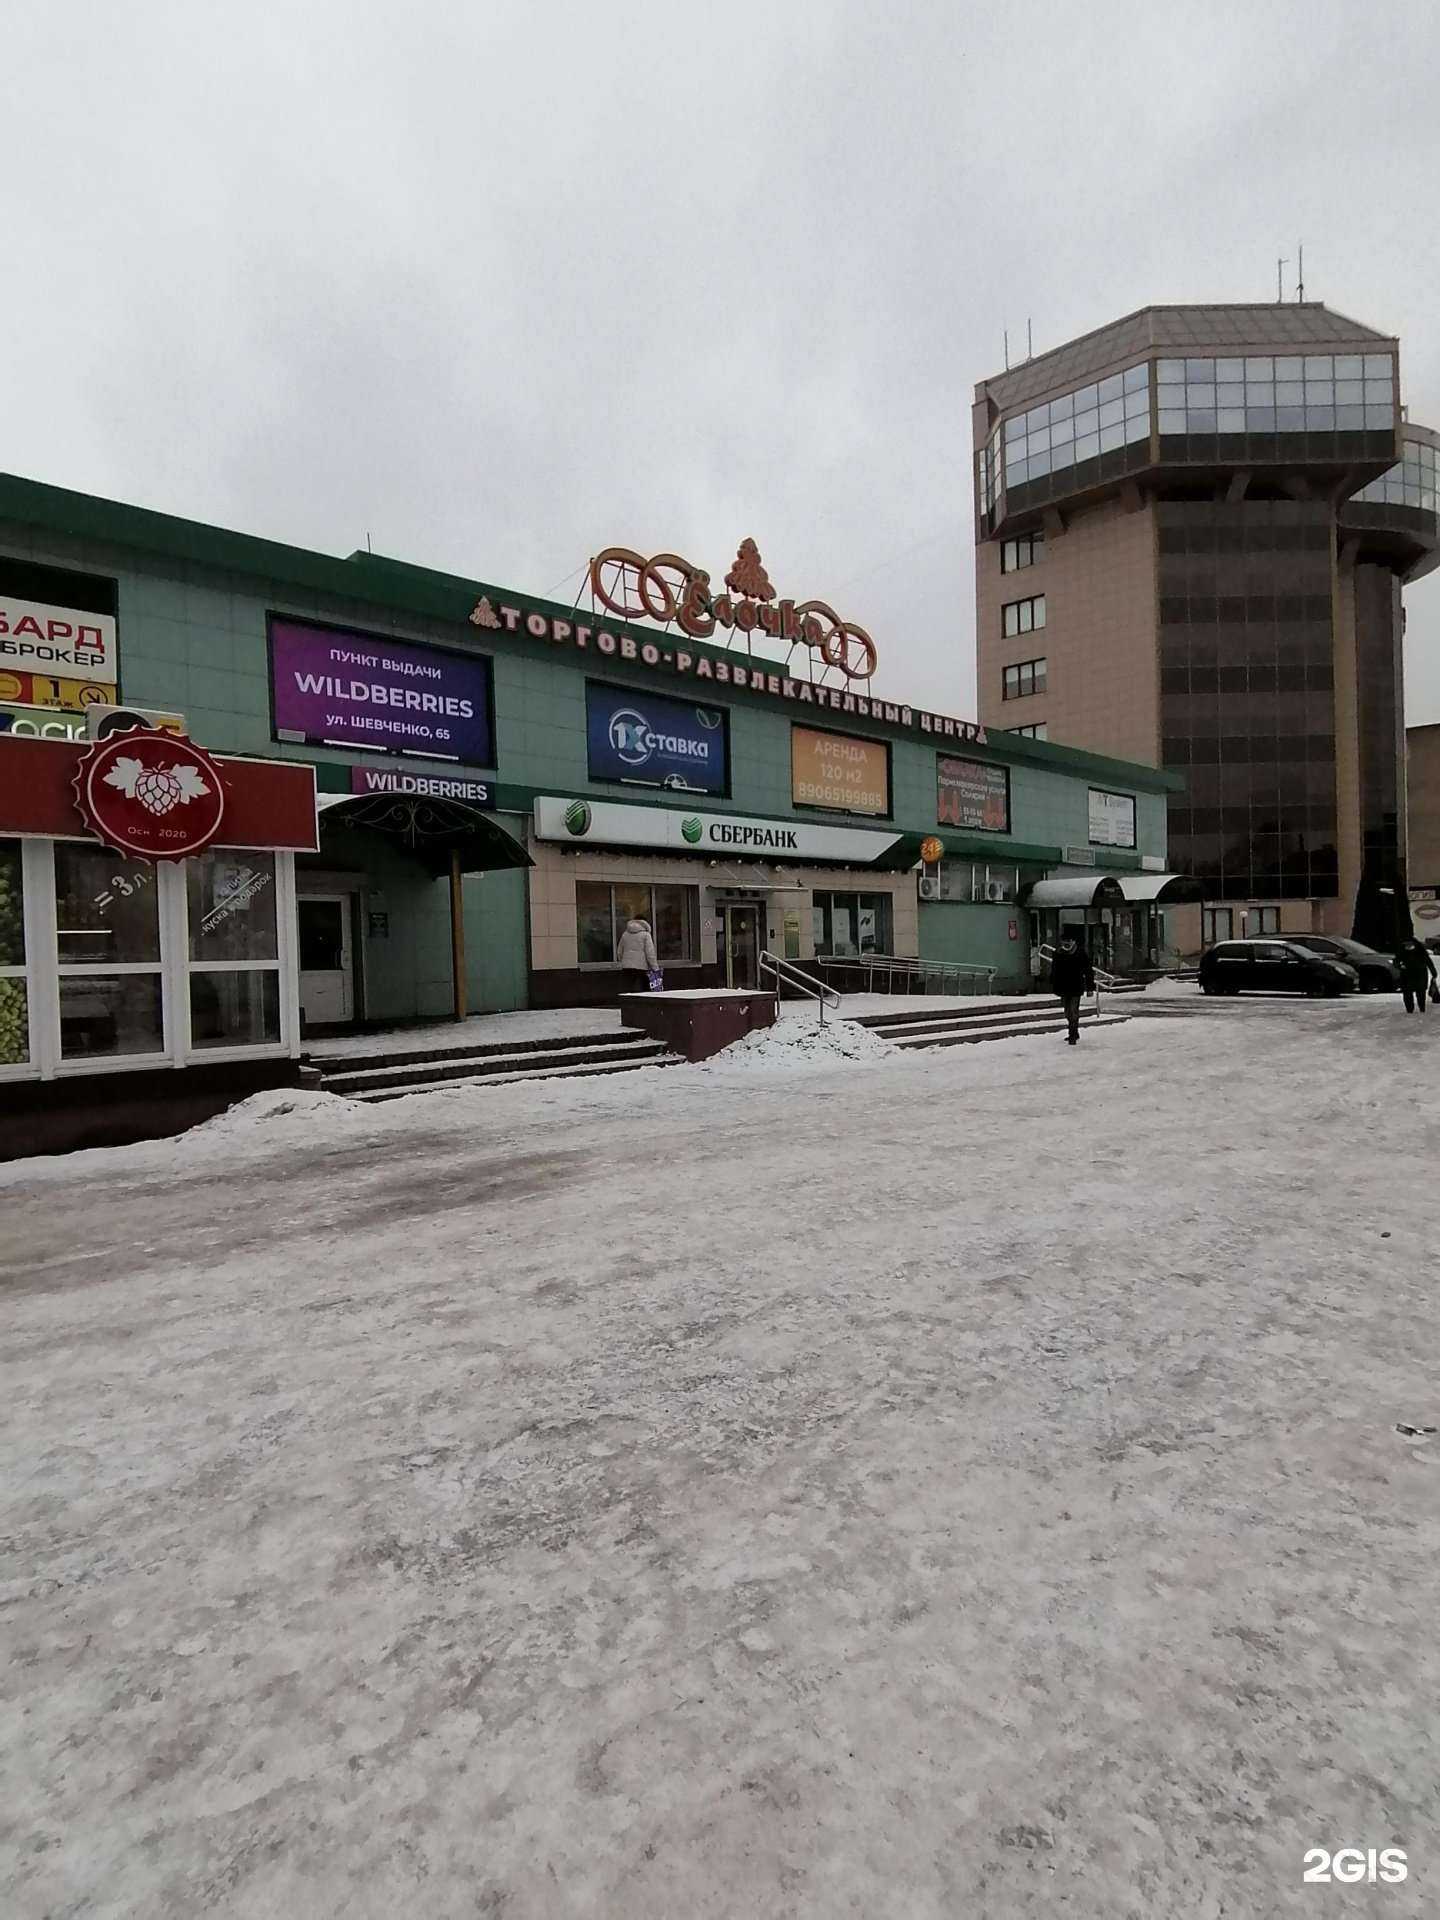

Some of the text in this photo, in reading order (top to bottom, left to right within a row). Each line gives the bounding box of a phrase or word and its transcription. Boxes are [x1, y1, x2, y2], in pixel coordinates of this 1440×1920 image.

[330, 649, 442, 680] ПУНКТ ВЫДАЧИ
[500, 606, 977, 741] ТОРГОВО-РАЗВЛЕКАТЕЛЬНЫЙ ЦЕНТР
[294, 671, 474, 719] WILDBERRIES
[326, 714, 451, 740] ул. ШЕВЧЕНКО, 65
[814, 740, 868, 764] АРЕНДА
[821, 763, 842, 779] 120
[366, 771, 488, 801] WILDBERRIES
[158, 828, 187, 839] 2020
[709, 823, 798, 849] СБЕРБАНК
